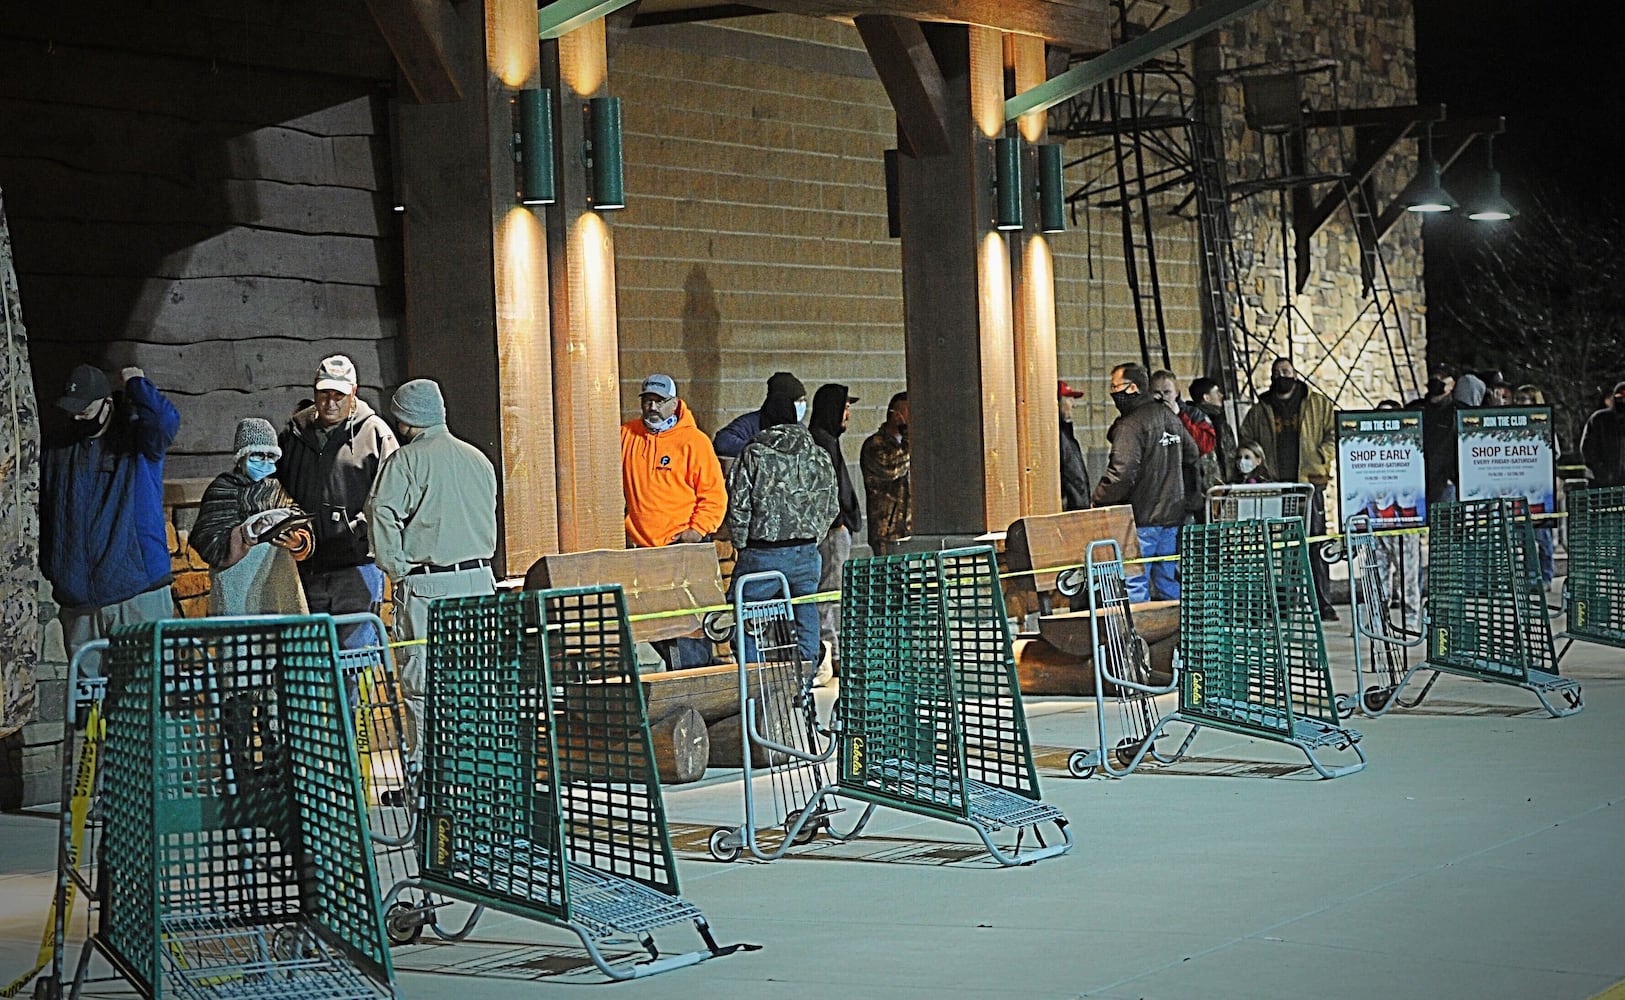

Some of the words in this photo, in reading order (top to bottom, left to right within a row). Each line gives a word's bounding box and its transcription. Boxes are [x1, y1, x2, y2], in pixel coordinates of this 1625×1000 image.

[1360, 420, 1373, 431] JOIN
[1373, 420, 1385, 431] THE
[1385, 419, 1400, 430] CLUB
[1483, 416, 1497, 427] JOIN
[1497, 416, 1510, 427] THE
[1511, 416, 1527, 426] CLUB
[1350, 450, 1377, 462] SHOP
[1380, 449, 1411, 461] EARLY
[1472, 446, 1501, 457] SHOP
[1505, 445, 1539, 456] EARLY
